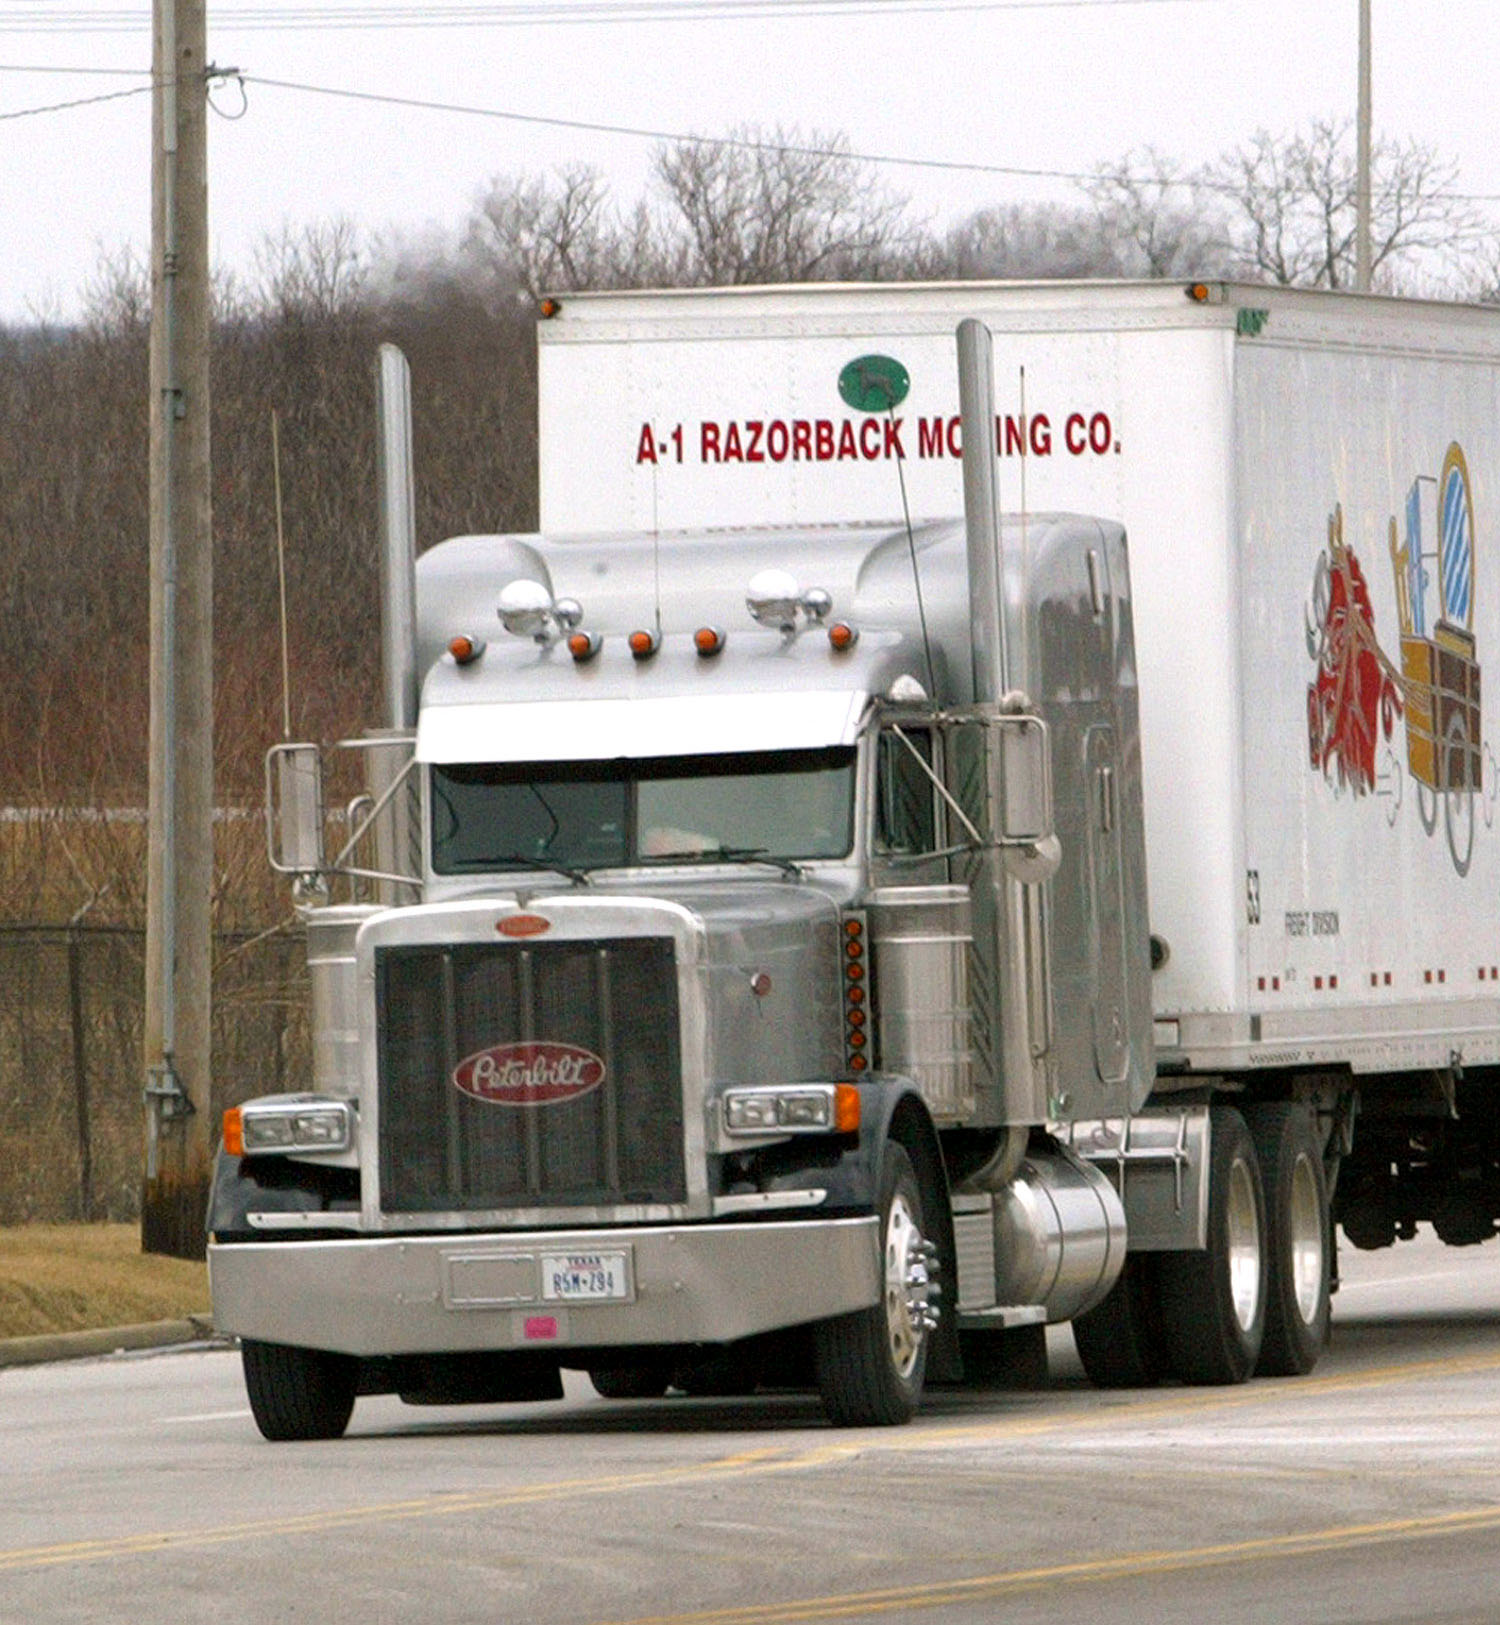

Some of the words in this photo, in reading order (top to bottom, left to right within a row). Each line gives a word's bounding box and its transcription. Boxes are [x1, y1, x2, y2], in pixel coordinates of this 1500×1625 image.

[636, 421, 683, 464] A-1
[700, 417, 906, 464] RAZORBACK
[918, 412, 1051, 459] MOING
[1065, 411, 1121, 456] CO.
[471, 1054, 594, 1092] Peterbilt
